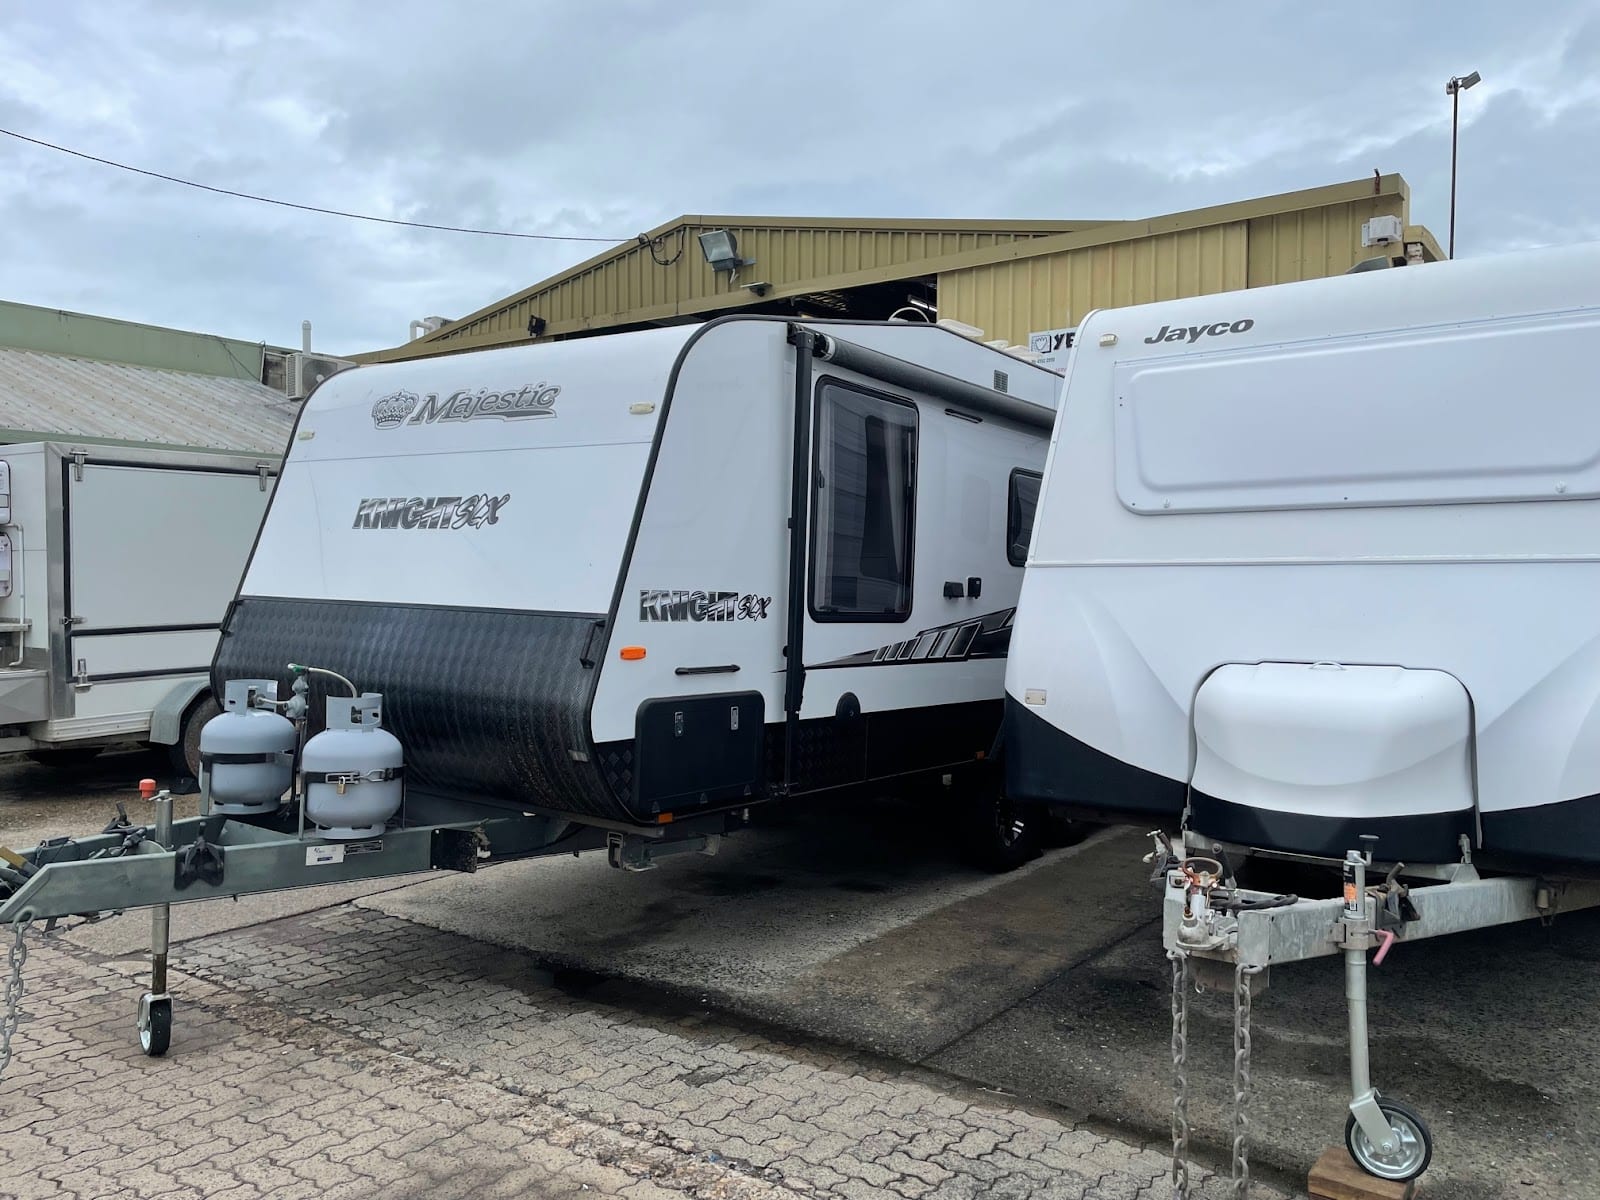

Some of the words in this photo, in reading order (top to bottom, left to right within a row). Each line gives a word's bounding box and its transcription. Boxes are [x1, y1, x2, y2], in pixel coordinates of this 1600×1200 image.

[1144, 319, 1254, 344] Jayco
[407, 382, 561, 425] Majestic
[639, 589, 739, 622] KNIGHT
